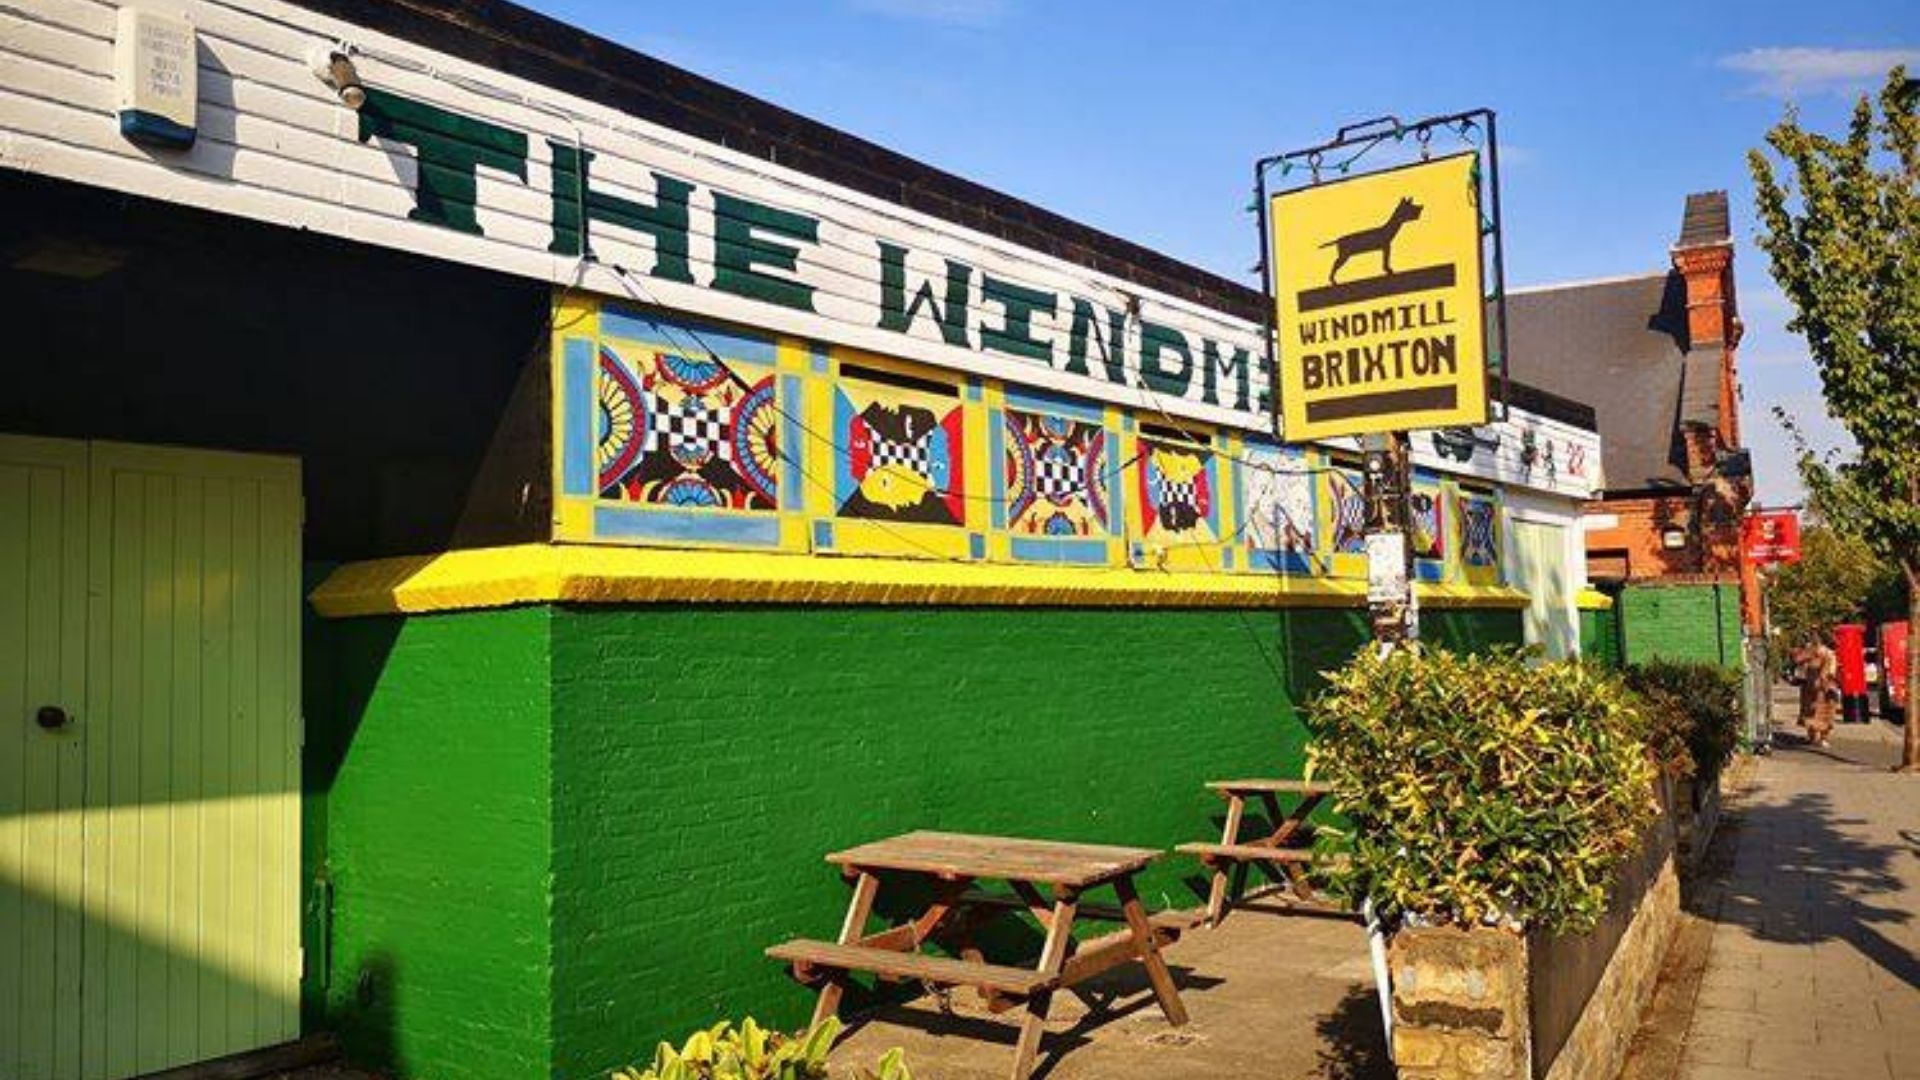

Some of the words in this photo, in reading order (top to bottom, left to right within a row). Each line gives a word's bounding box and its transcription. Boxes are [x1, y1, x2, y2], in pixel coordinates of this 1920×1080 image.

[359, 84, 820, 313] THE
[876, 240, 1271, 412] WINDM
[1299, 300, 1454, 345] WINDMILL
[1302, 335, 1457, 389] BRIXTON
